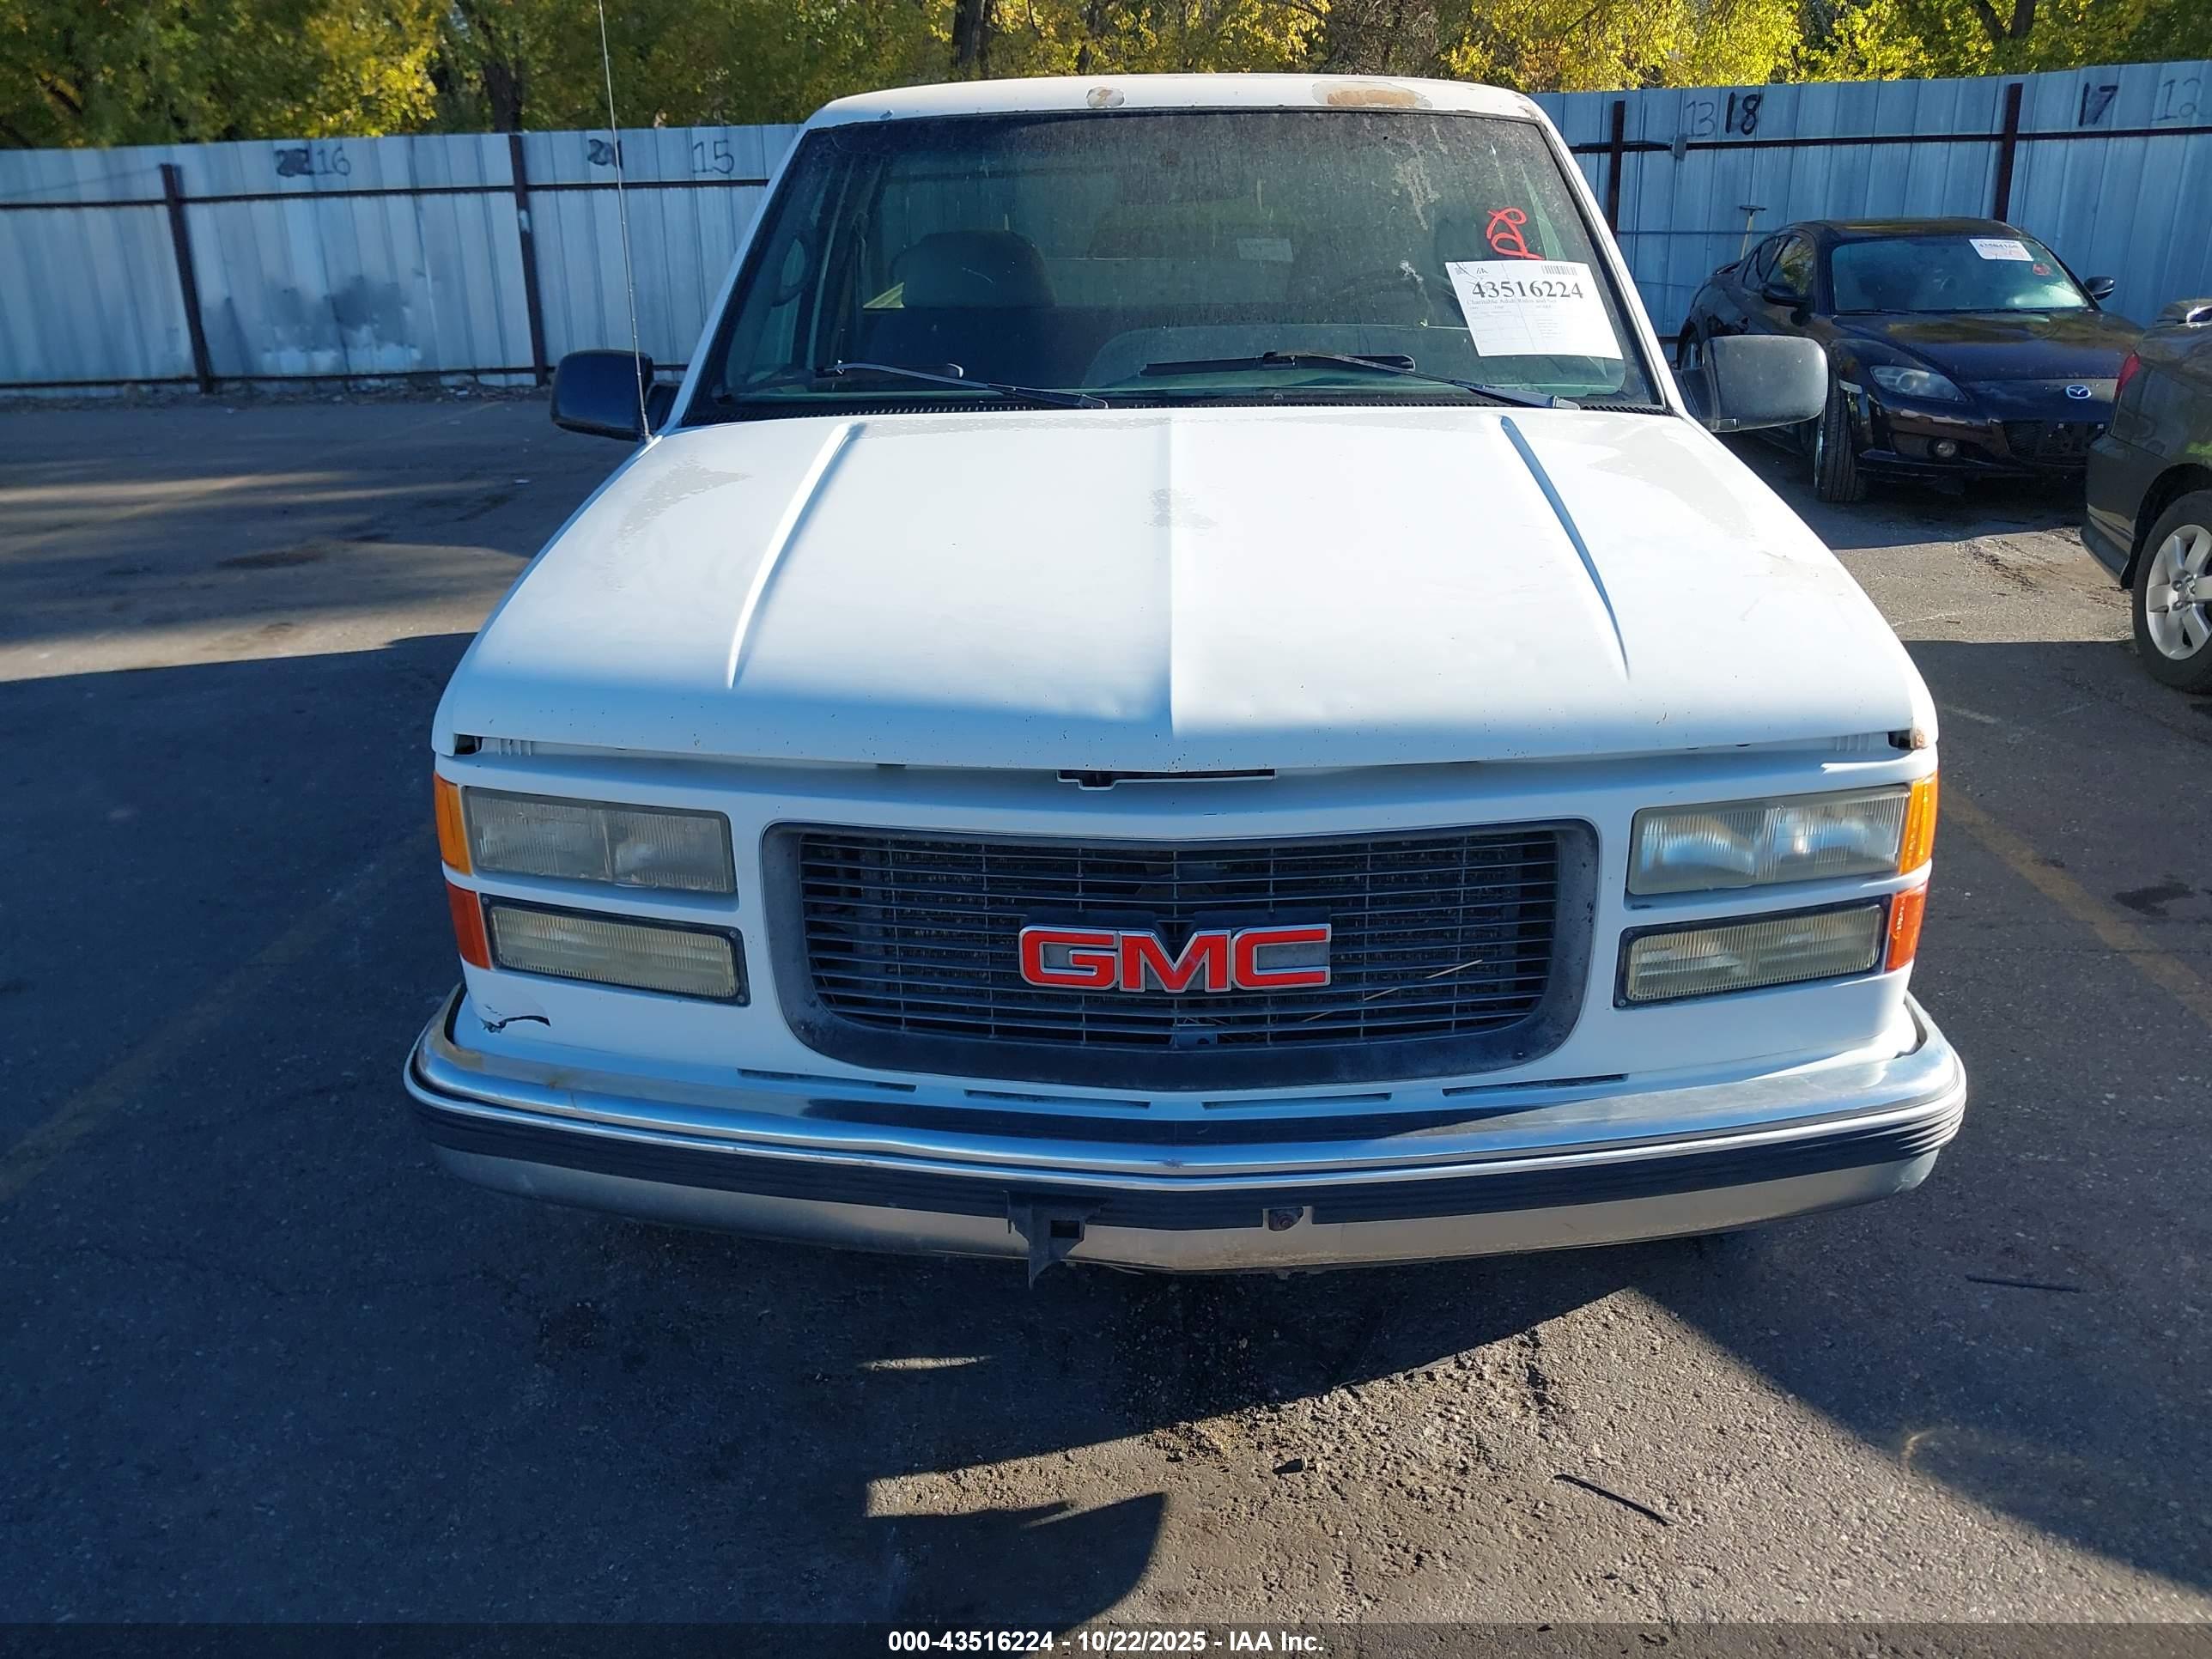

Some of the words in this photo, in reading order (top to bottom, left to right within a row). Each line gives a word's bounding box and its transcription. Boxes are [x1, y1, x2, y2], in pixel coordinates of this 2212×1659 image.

[1686, 100, 1716, 137] 13
[1725, 92, 1761, 136] 18
[2078, 82, 2118, 127] 17
[315, 145, 351, 177] 16
[692, 139, 735, 174] 15
[1472, 280, 1584, 299] 43516224
[1018, 923, 1332, 994] GMC
